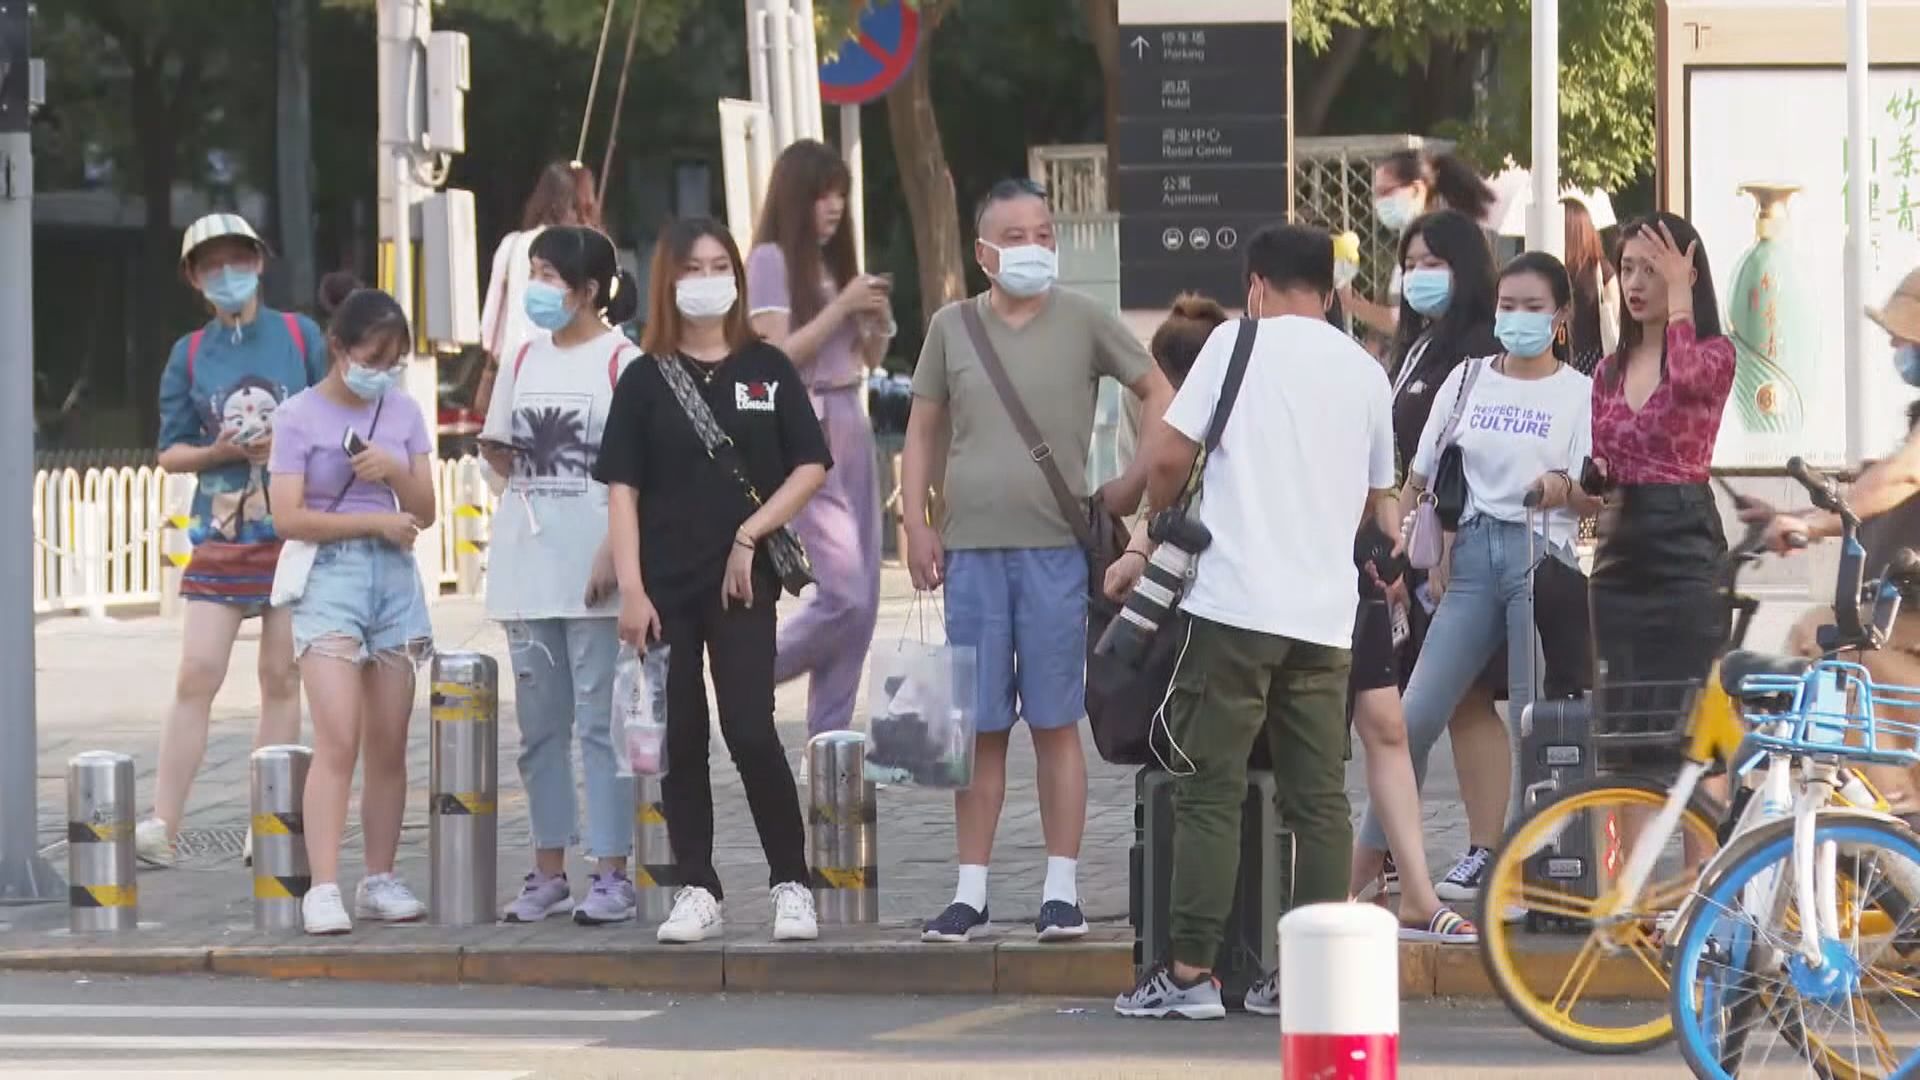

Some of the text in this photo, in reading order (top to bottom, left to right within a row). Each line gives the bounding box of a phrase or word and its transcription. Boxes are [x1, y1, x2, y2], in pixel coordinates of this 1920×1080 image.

[1163, 48, 1205, 61] Parking
[1162, 97, 1190, 109] Hotel
[1162, 128, 1221, 143] 商业中心
[1162, 145, 1232, 157] Retail Center
[1162, 193, 1219, 206] Apartment
[1522, 408, 1534, 419] IS
[1535, 410, 1552, 421] MY
[1470, 414, 1551, 438] CULTURE
